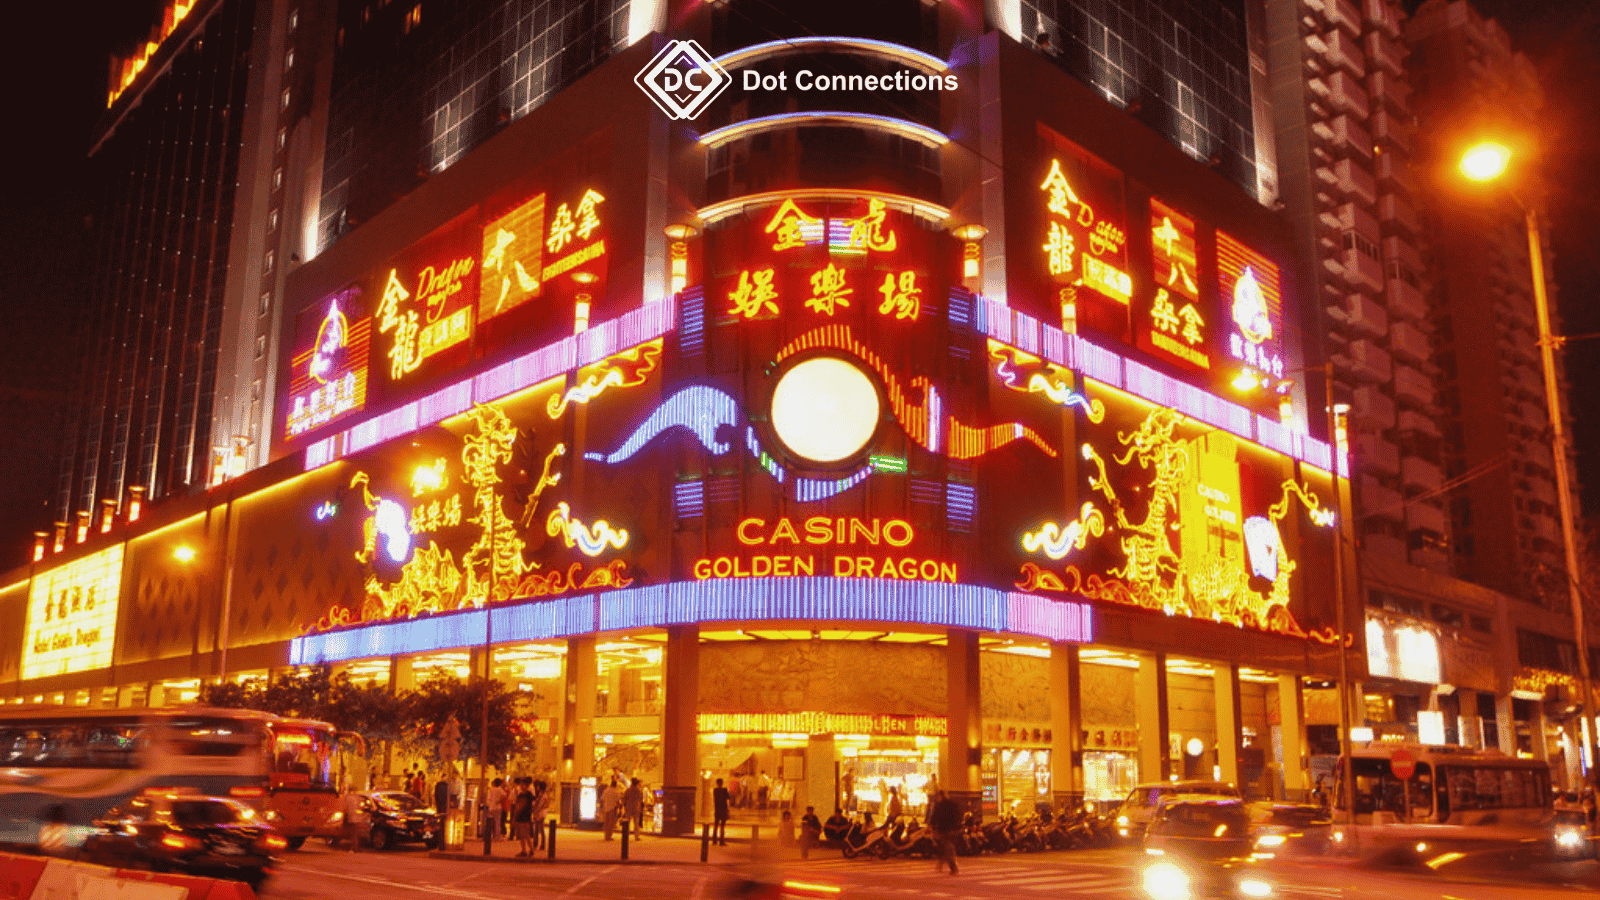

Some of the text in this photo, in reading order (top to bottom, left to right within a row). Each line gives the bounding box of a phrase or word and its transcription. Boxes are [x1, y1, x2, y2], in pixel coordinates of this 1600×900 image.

[546, 188, 605, 253] 桑拿
[765, 198, 897, 252] 金龍
[1040, 158, 1079, 276] 金龍
[482, 228, 539, 313] 十八
[1151, 216, 1199, 295] 十八
[727, 262, 922, 321] 娛樂場
[1150, 287, 1205, 345] 桑拿
[374, 267, 425, 381] 金龍
[737, 516, 914, 547] CASINO
[694, 555, 957, 584] GOLDEN DRAGON
